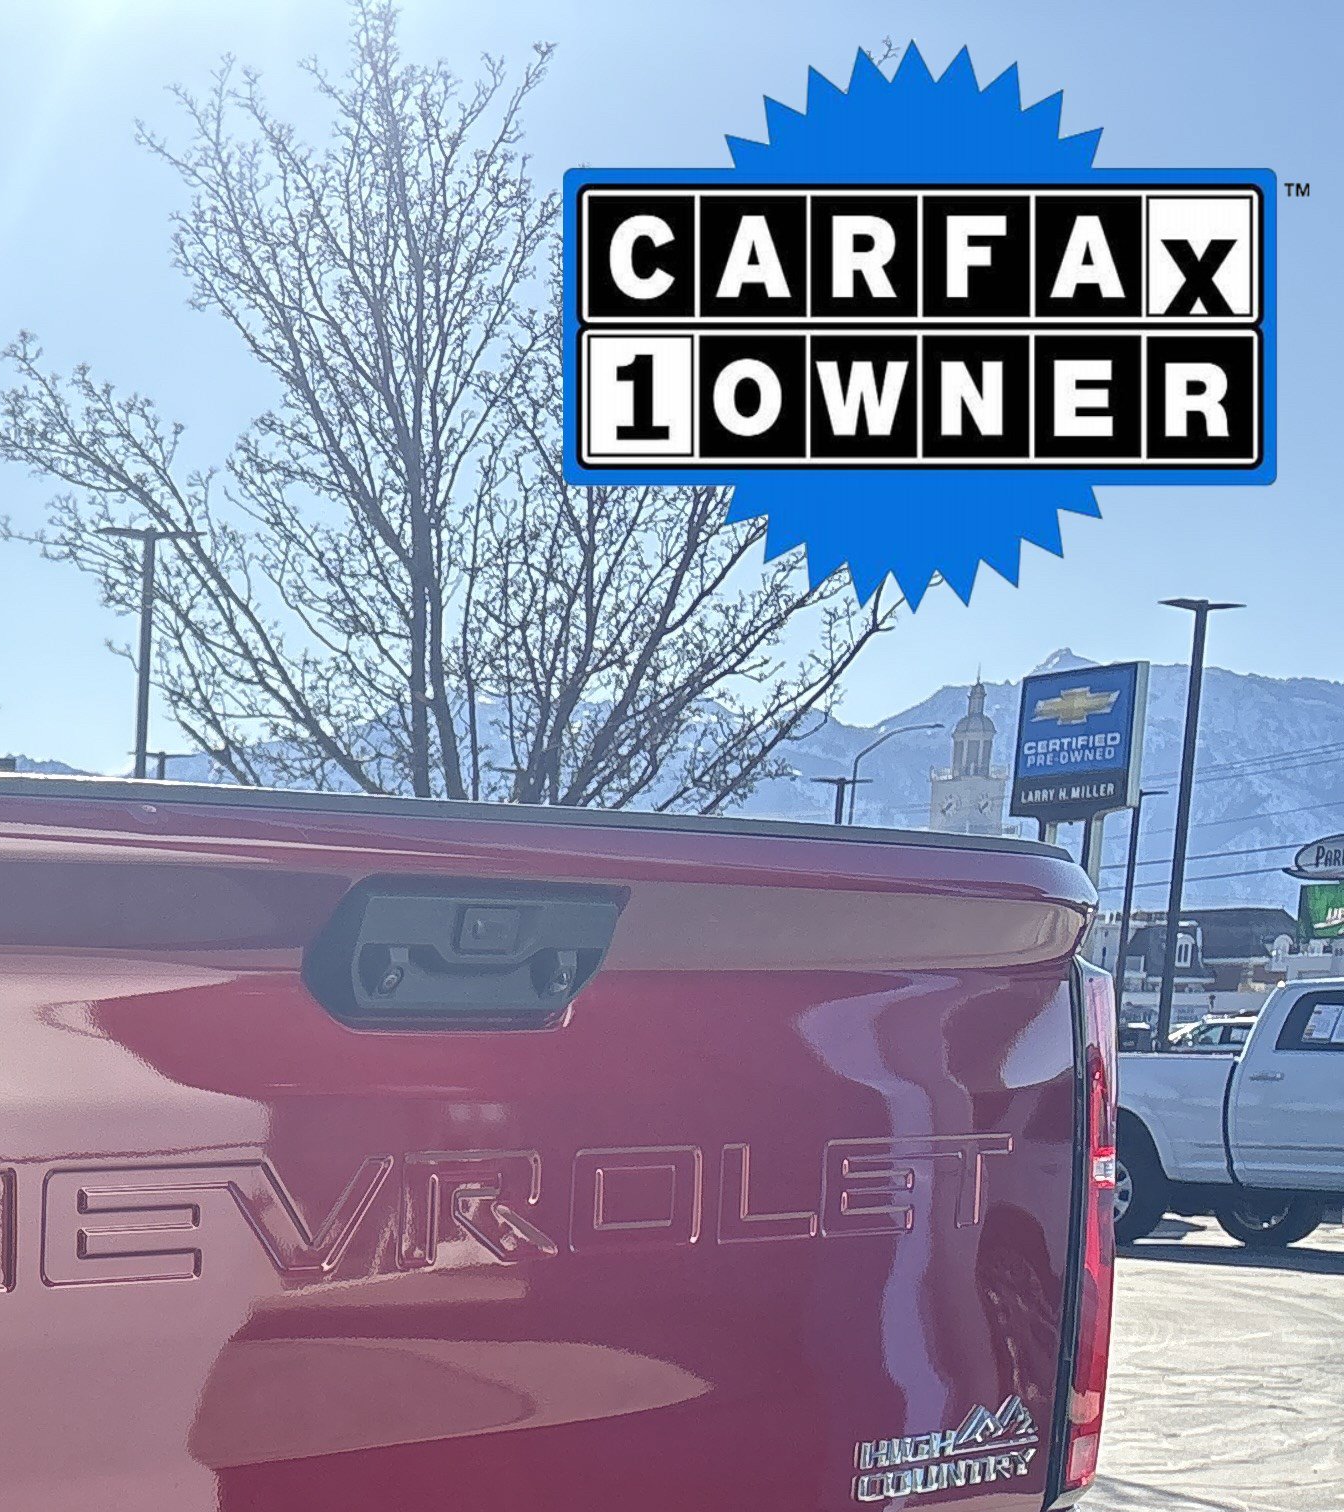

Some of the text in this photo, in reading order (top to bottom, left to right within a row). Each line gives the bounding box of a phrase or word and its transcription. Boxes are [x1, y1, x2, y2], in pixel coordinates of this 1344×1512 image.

[1023, 732, 1121, 755] CERTIFIED
[1026, 747, 1115, 767] PRE-OWNED
[1021, 787, 1055, 803] LARRY
[1071, 783, 1115, 799] MILLER
[1315, 845, 1344, 868] PAR
[854, 1429, 959, 1470] HIGH
[851, 1448, 1037, 1502] COUNTRY
